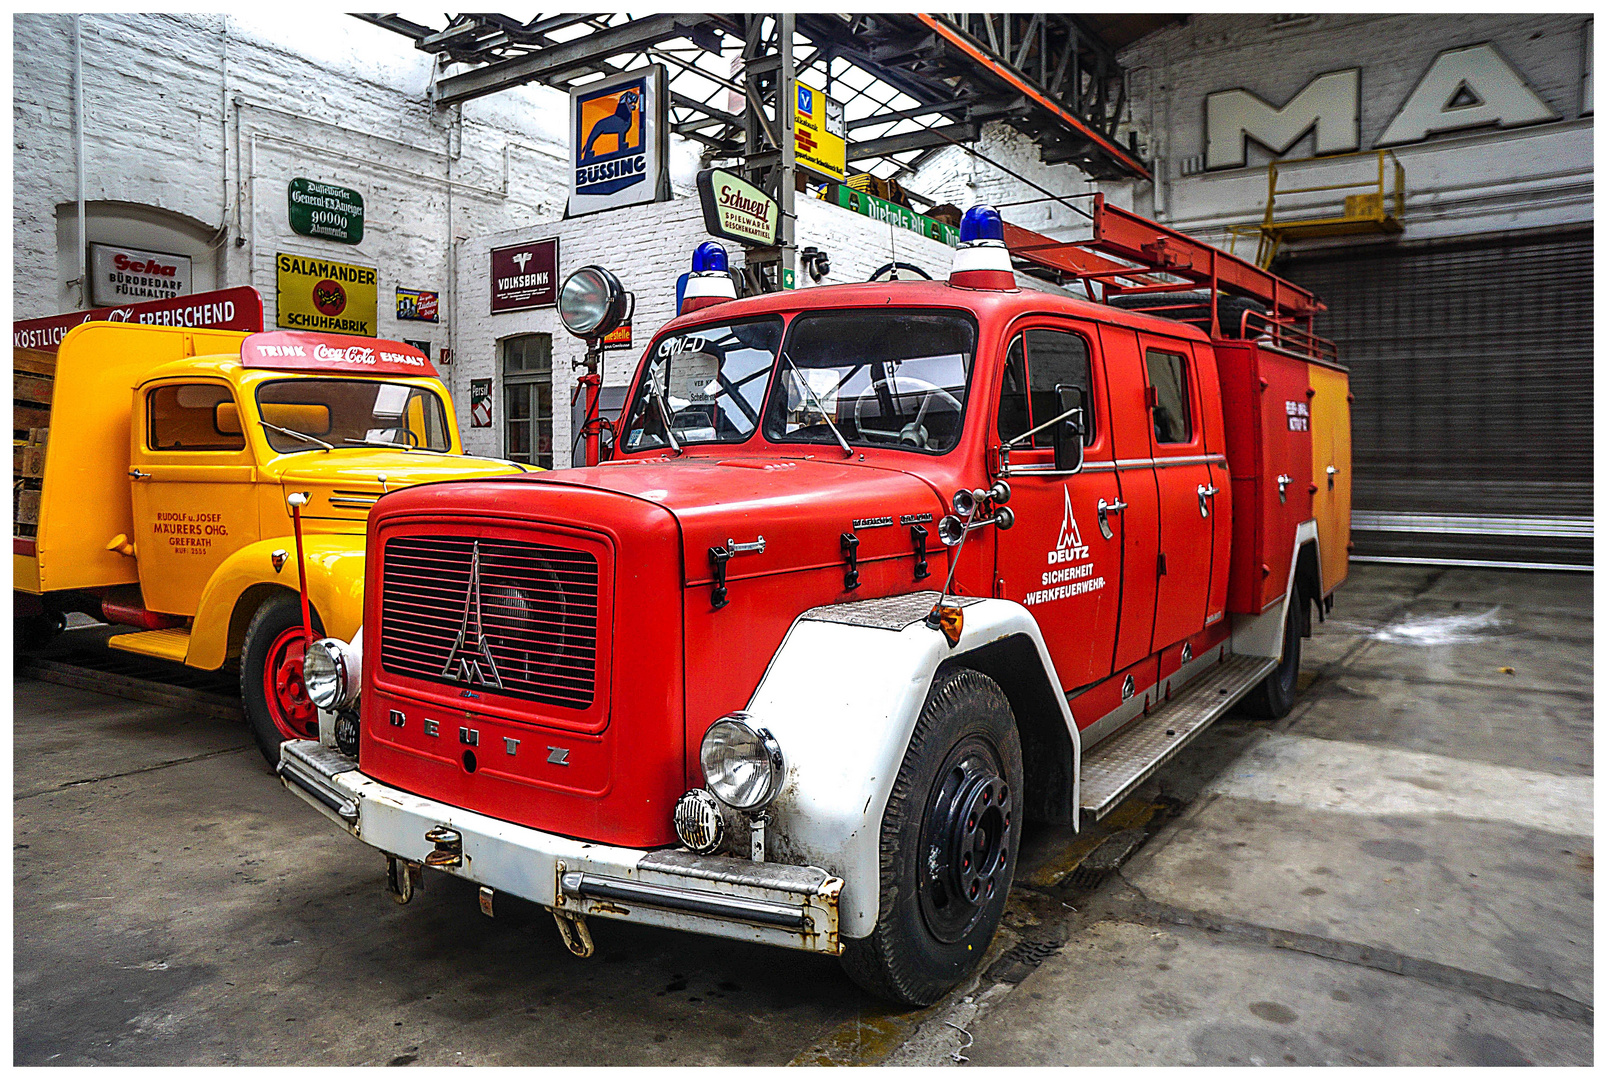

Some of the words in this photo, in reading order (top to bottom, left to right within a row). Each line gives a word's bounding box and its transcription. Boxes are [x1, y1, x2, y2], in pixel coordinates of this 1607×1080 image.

[1206, 18, 1594, 171] MA
[576, 155, 647, 185] BÜSSING
[719, 185, 771, 222] Schnepf
[311, 210, 348, 229] 90000
[725, 212, 770, 230] SPIELWAREN
[725, 220, 771, 239] GESCHENKARTIKEL
[280, 256, 375, 285] SALAMANDER
[498, 271, 549, 290] VOLKSBANK
[109, 272, 182, 290] BÜROBEDARF
[116, 284, 177, 299] FÜLLHALTER
[13, 326, 68, 348] KÖSTLICH
[139, 300, 235, 327] ERFRISCHEND
[287, 312, 368, 334] SCHUHFABRIK
[256, 345, 307, 357] TRINK
[313, 343, 377, 365] Coca-Cola
[379, 352, 425, 366] EISKALT
[658, 335, 706, 357] GW-D
[472, 384, 489, 398] Persil
[157, 512, 187, 521] RUDOLF
[196, 513, 222, 522] JOSEF
[153, 523, 202, 535] MÄURERS
[204, 525, 229, 536] OHG.
[169, 537, 212, 547] GREFRATH
[1047, 545, 1090, 565] DEUTZ
[1041, 563, 1094, 586] SICHERHEIT
[389, 709, 570, 766] DEUTZ
